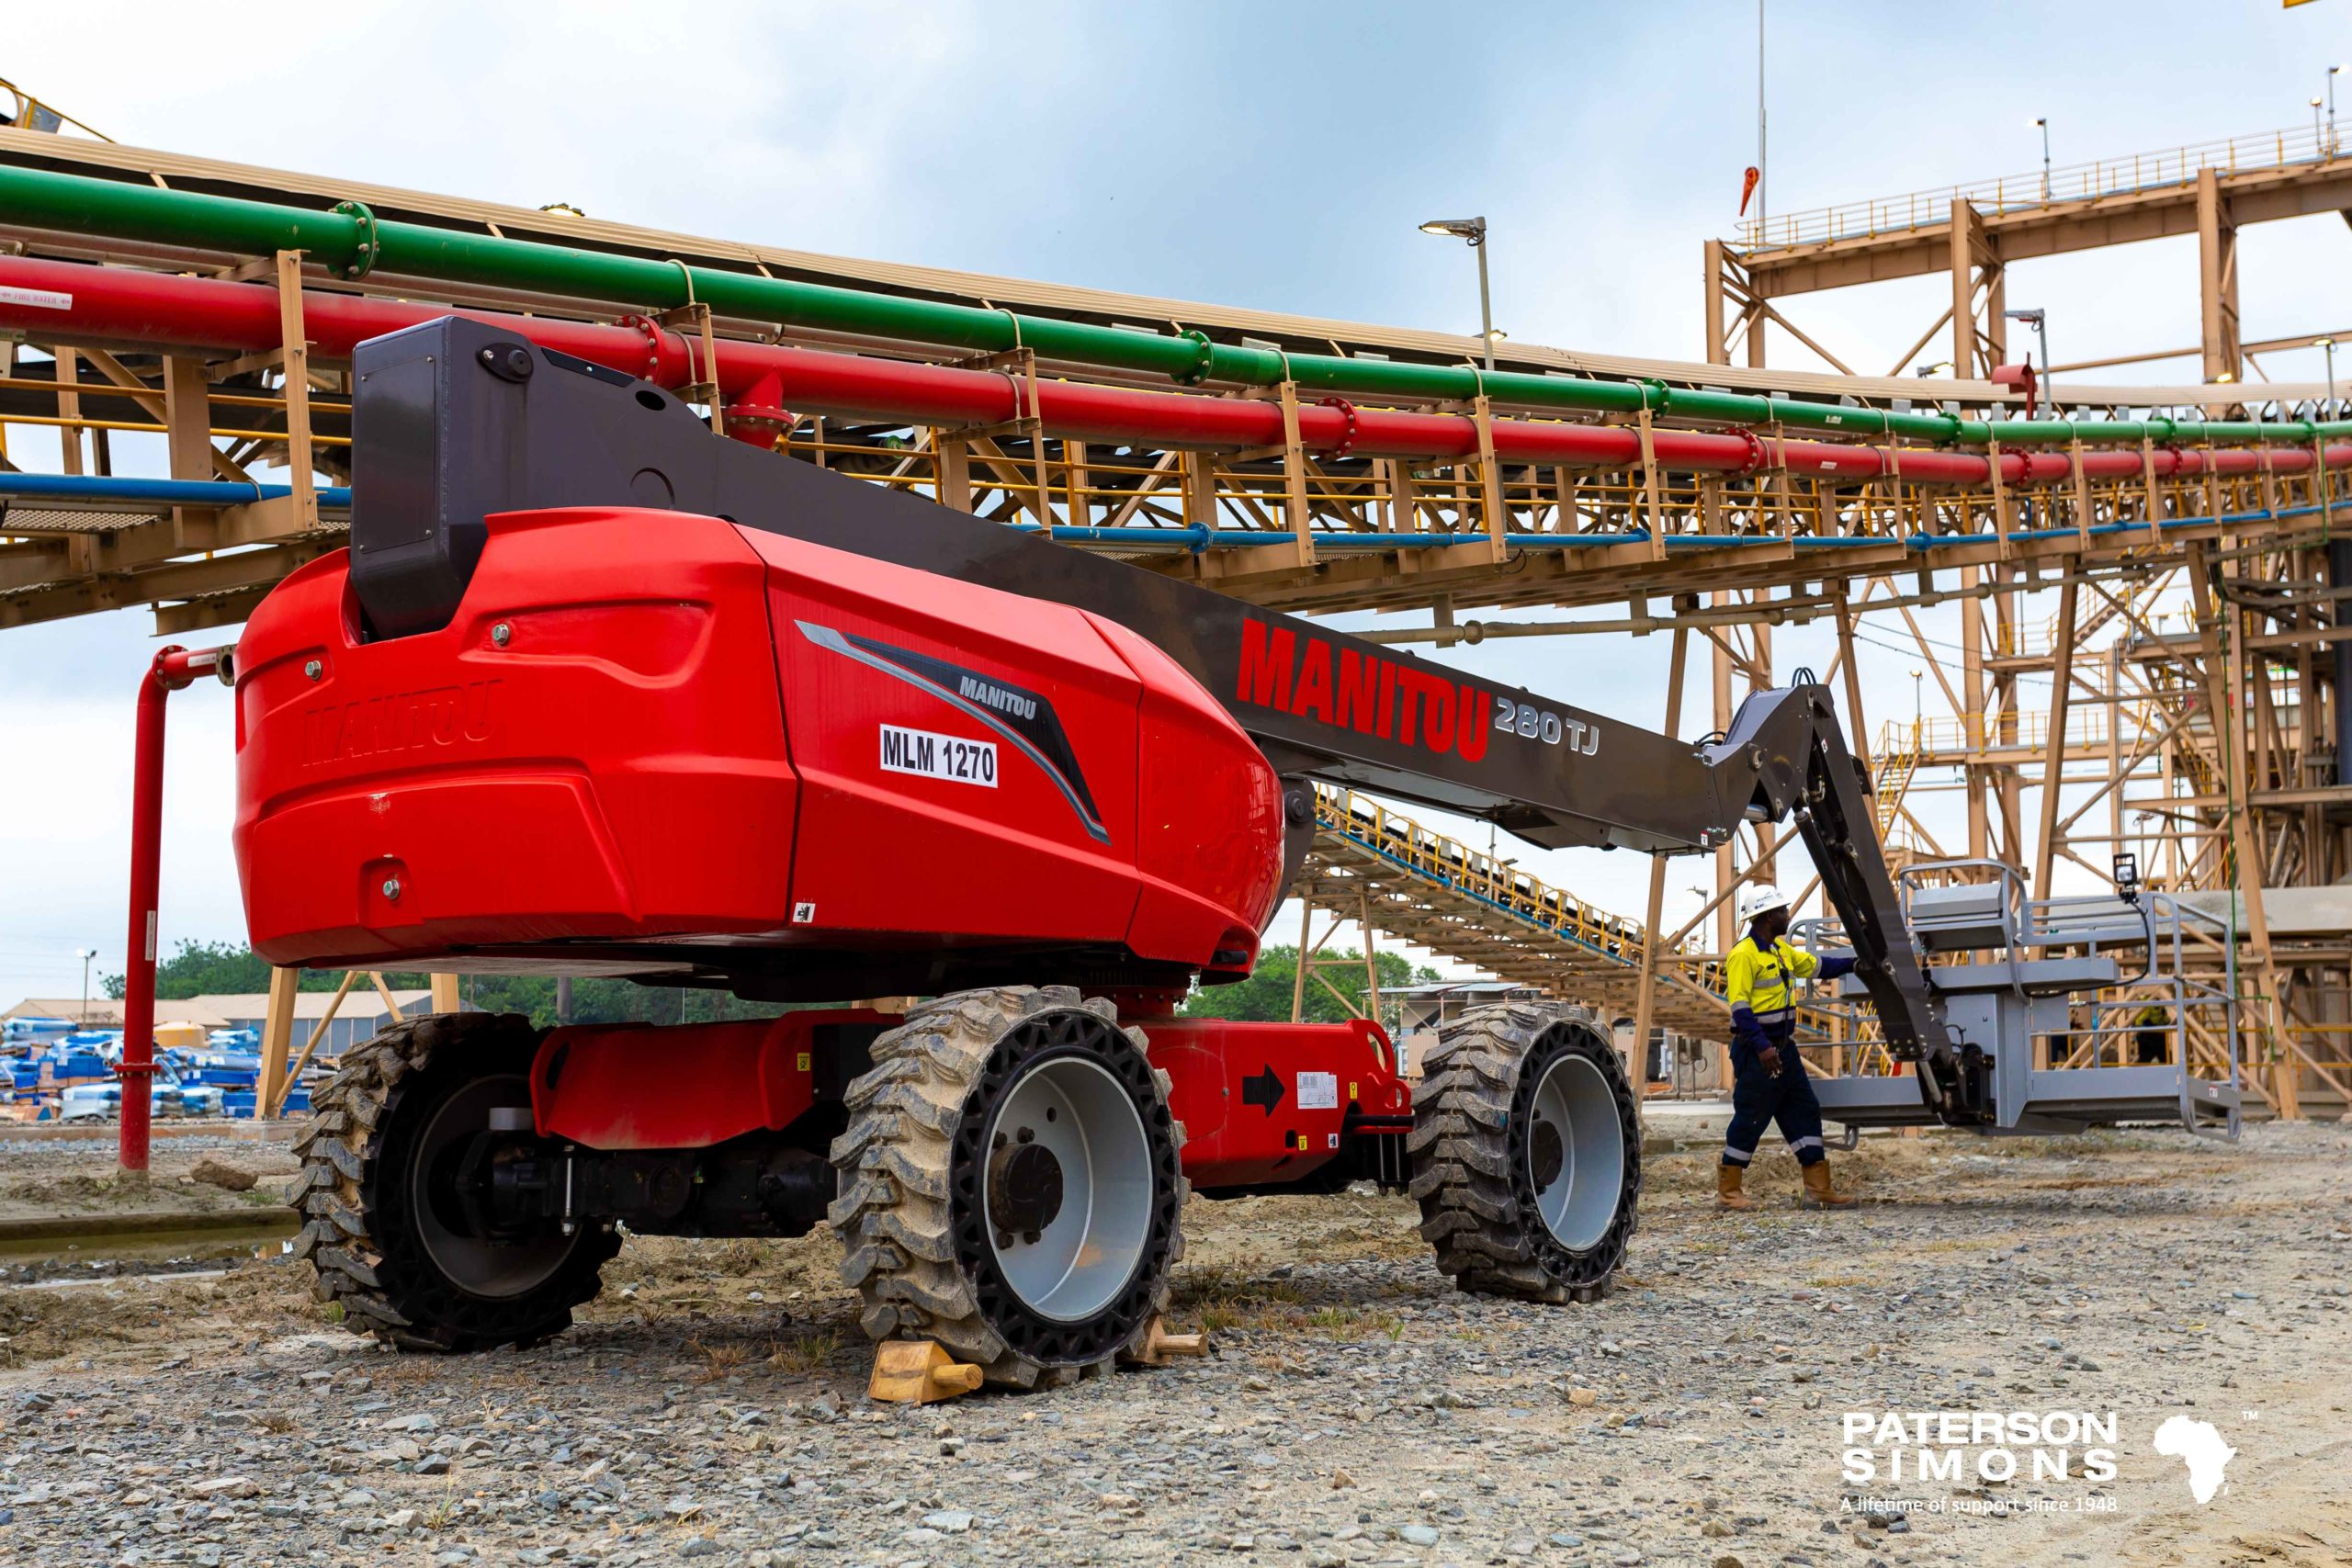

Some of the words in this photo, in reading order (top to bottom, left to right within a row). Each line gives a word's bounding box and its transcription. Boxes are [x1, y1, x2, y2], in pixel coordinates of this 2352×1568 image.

[959, 676, 1036, 720] MANITOU
[1236, 617, 1491, 762] MANITOU
[302, 679, 503, 767] MANITOU
[1494, 696, 1562, 745] 280
[1566, 716, 1600, 757] TJ
[883, 729, 934, 773] MLM
[943, 740, 994, 782] 1270
